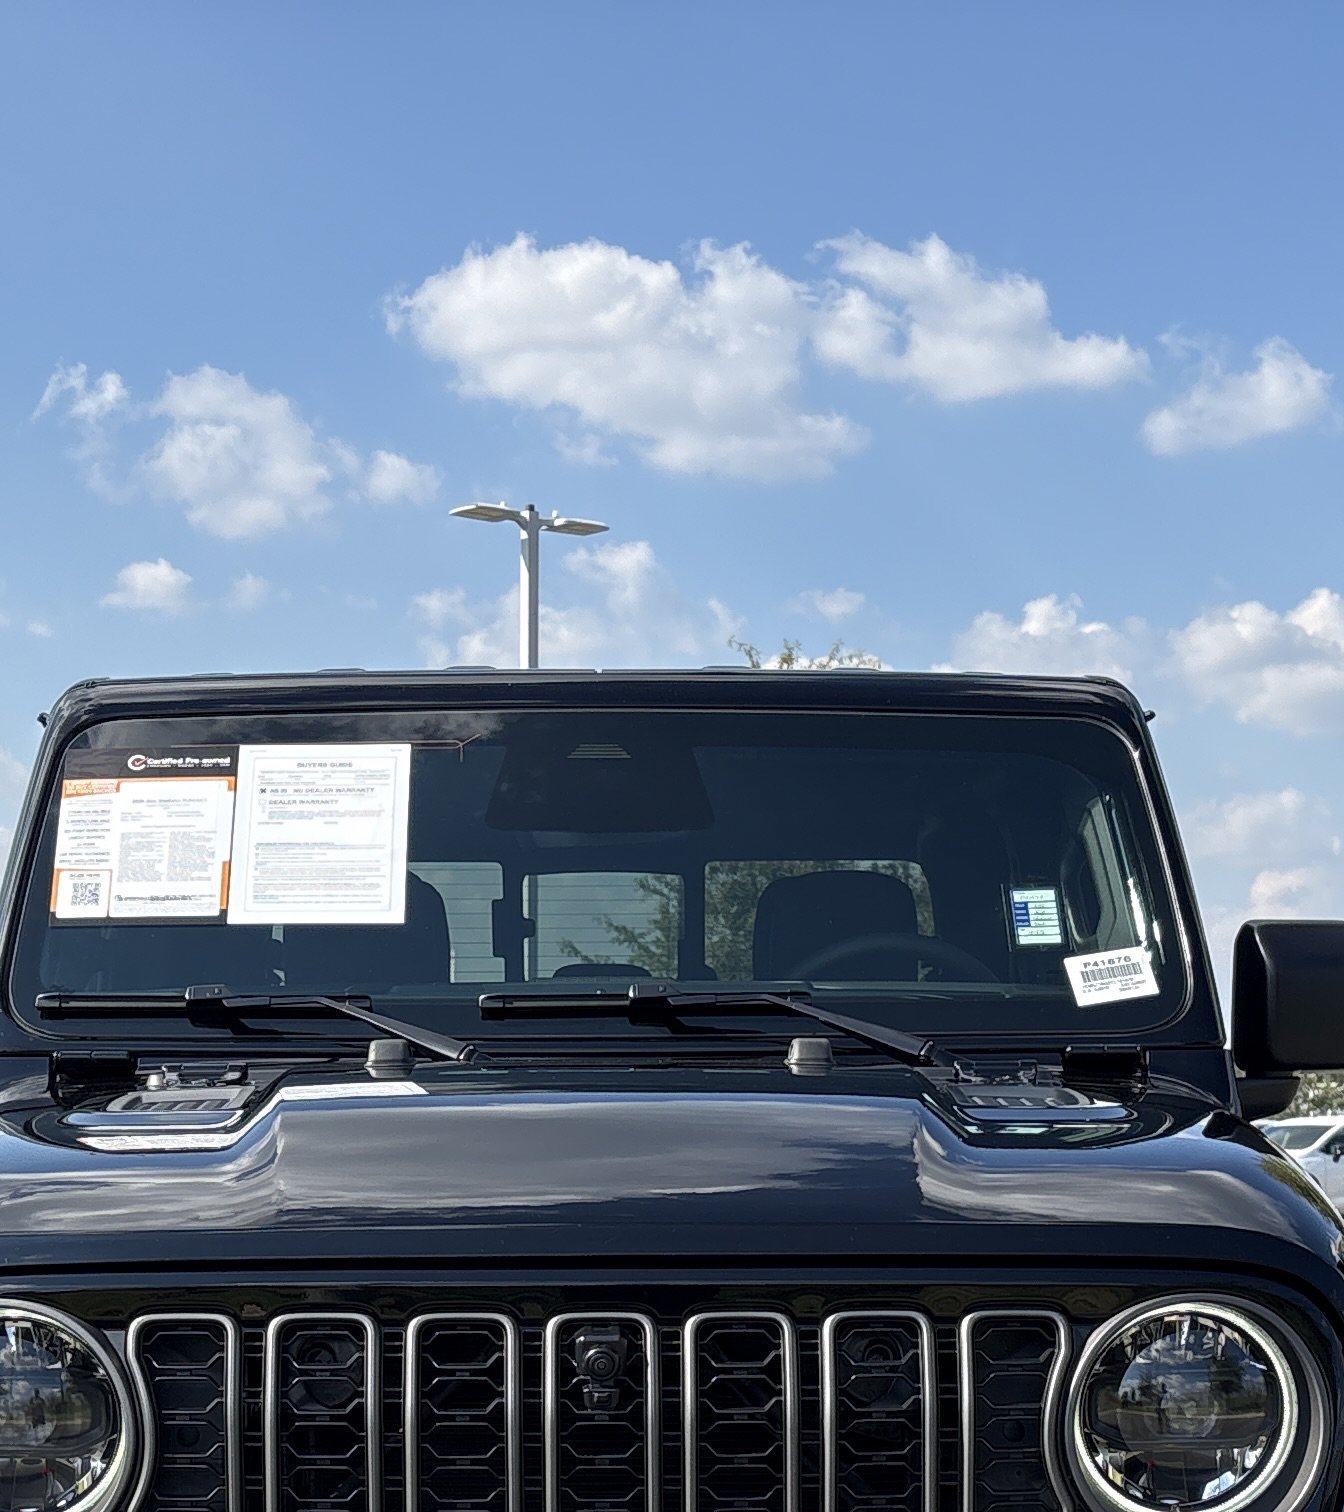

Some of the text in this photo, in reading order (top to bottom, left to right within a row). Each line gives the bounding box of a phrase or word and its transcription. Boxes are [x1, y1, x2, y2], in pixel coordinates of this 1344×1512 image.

[147, 756, 230, 765] Certified Pre-owned
[296, 761, 327, 769] BUYERS
